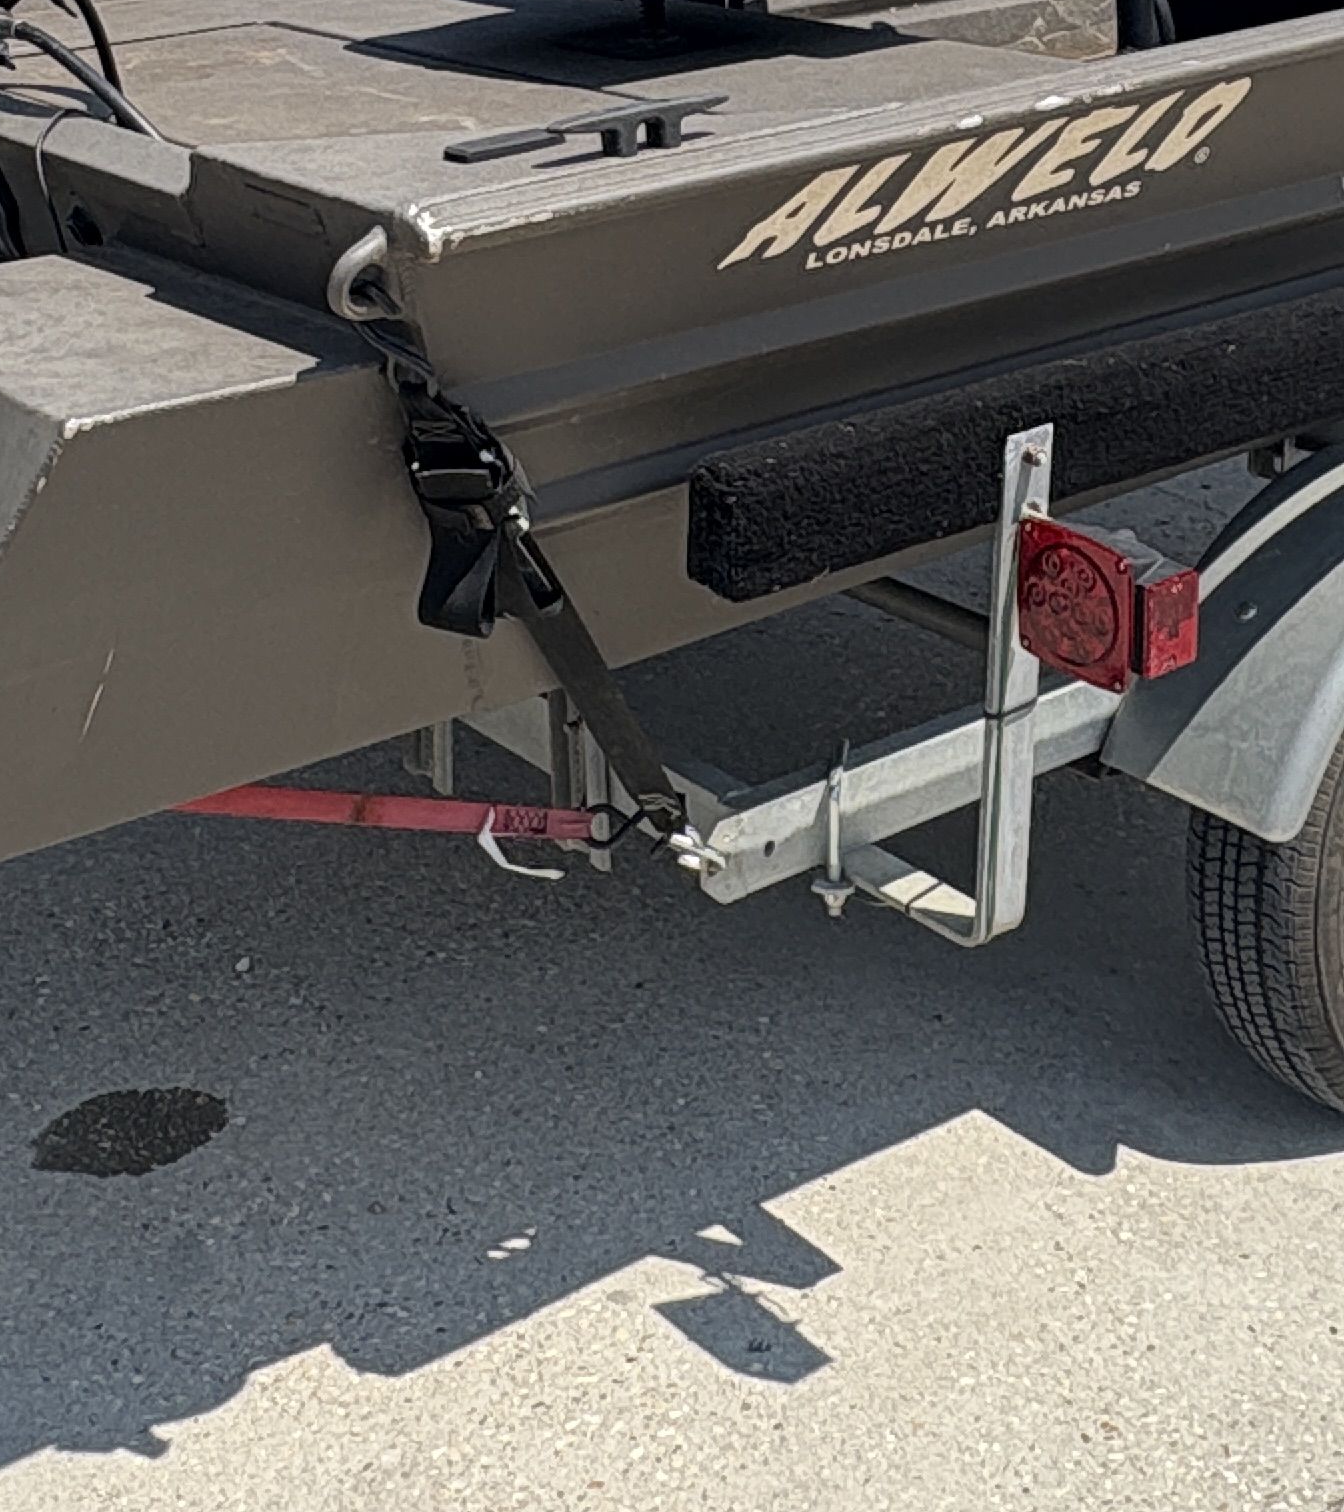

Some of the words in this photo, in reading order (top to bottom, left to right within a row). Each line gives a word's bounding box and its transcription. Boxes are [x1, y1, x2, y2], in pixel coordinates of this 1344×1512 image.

[717, 76, 1252, 271] ALWELD
[805, 216, 979, 271] LONSDALE,
[986, 179, 1143, 229] ARKANSAS
